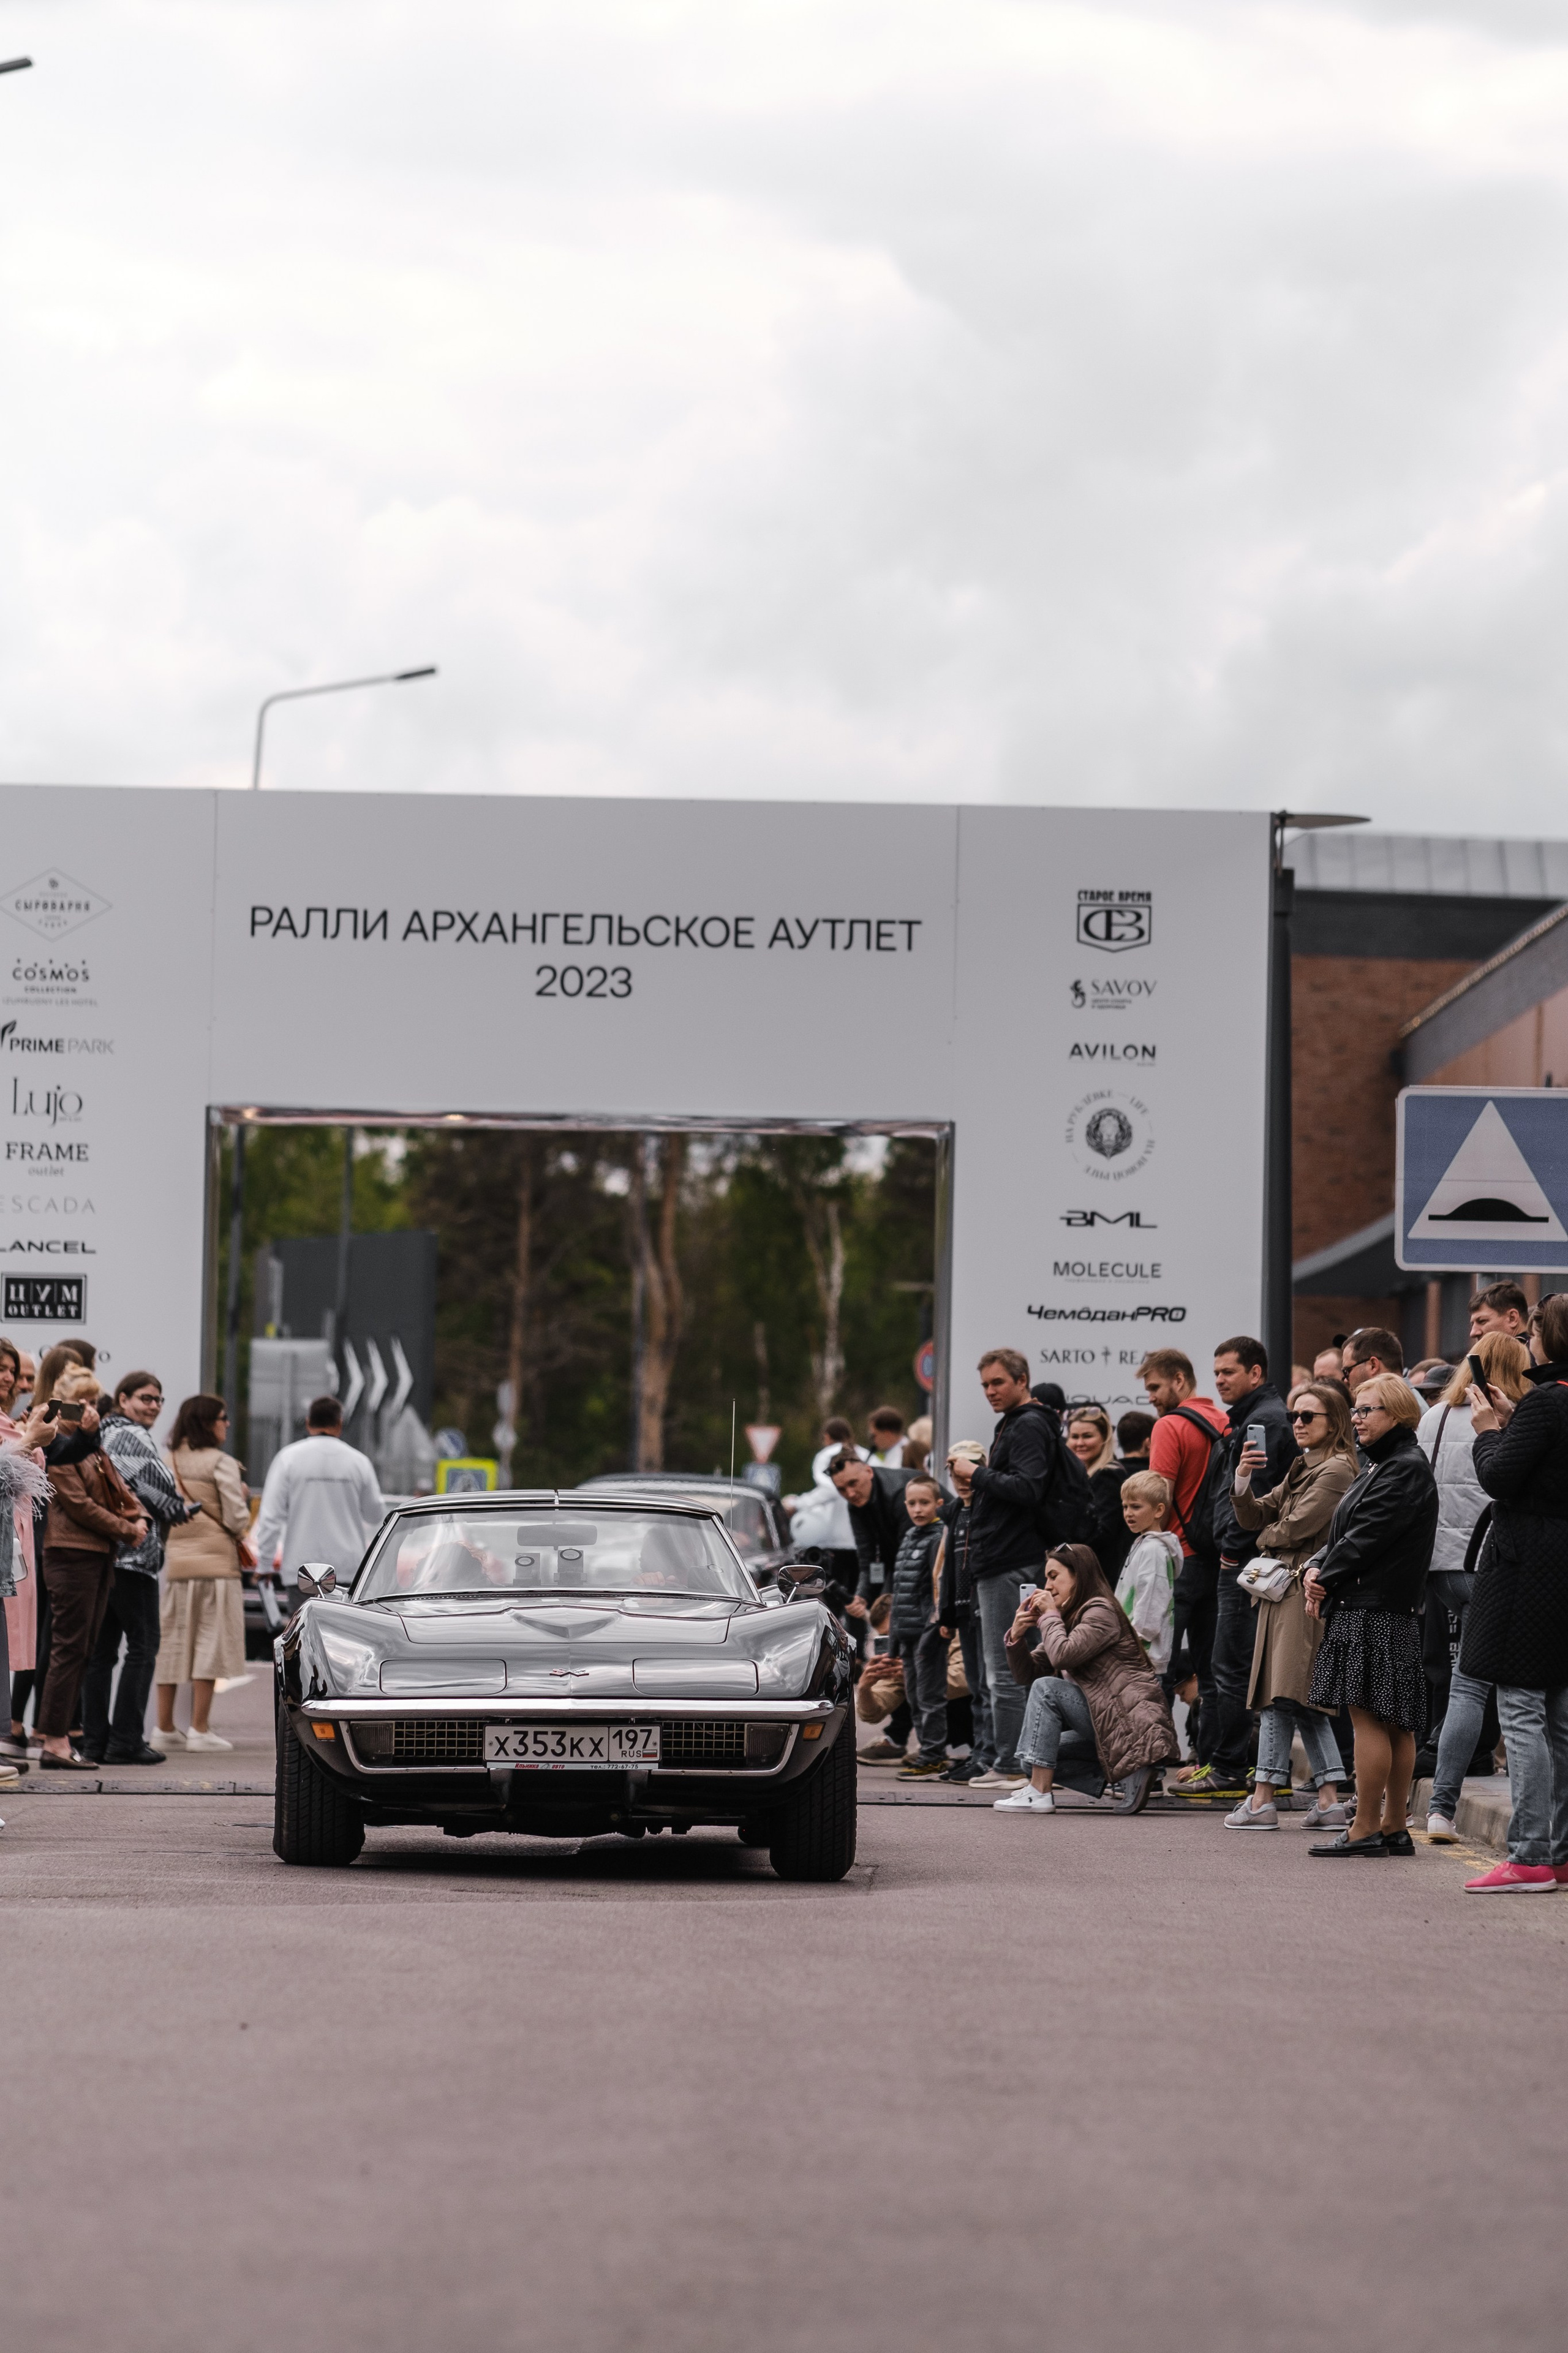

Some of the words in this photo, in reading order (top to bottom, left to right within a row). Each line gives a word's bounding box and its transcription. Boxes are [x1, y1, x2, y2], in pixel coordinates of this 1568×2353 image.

[1077, 890, 1115, 902] СТАРОЕ
[250, 905, 388, 940] РАЛЛИ
[402, 910, 755, 950] АРХАНГЕЛЬСКОЕ
[767, 917, 923, 952] АУТЛЕТ
[12, 967, 90, 981] COSMOS
[535, 965, 633, 999] 2023
[1091, 979, 1156, 997] SAVOY
[1069, 1043, 1156, 1060] AVILON
[13, 1076, 83, 1127] Lujo
[6, 1141, 89, 1162] FRAME
[1053, 1261, 1162, 1278] MOLECULE
[7, 1304, 78, 1317] OUTLET
[1041, 1349, 1095, 1364] SARTO
[612, 1729, 653, 1750] 197
